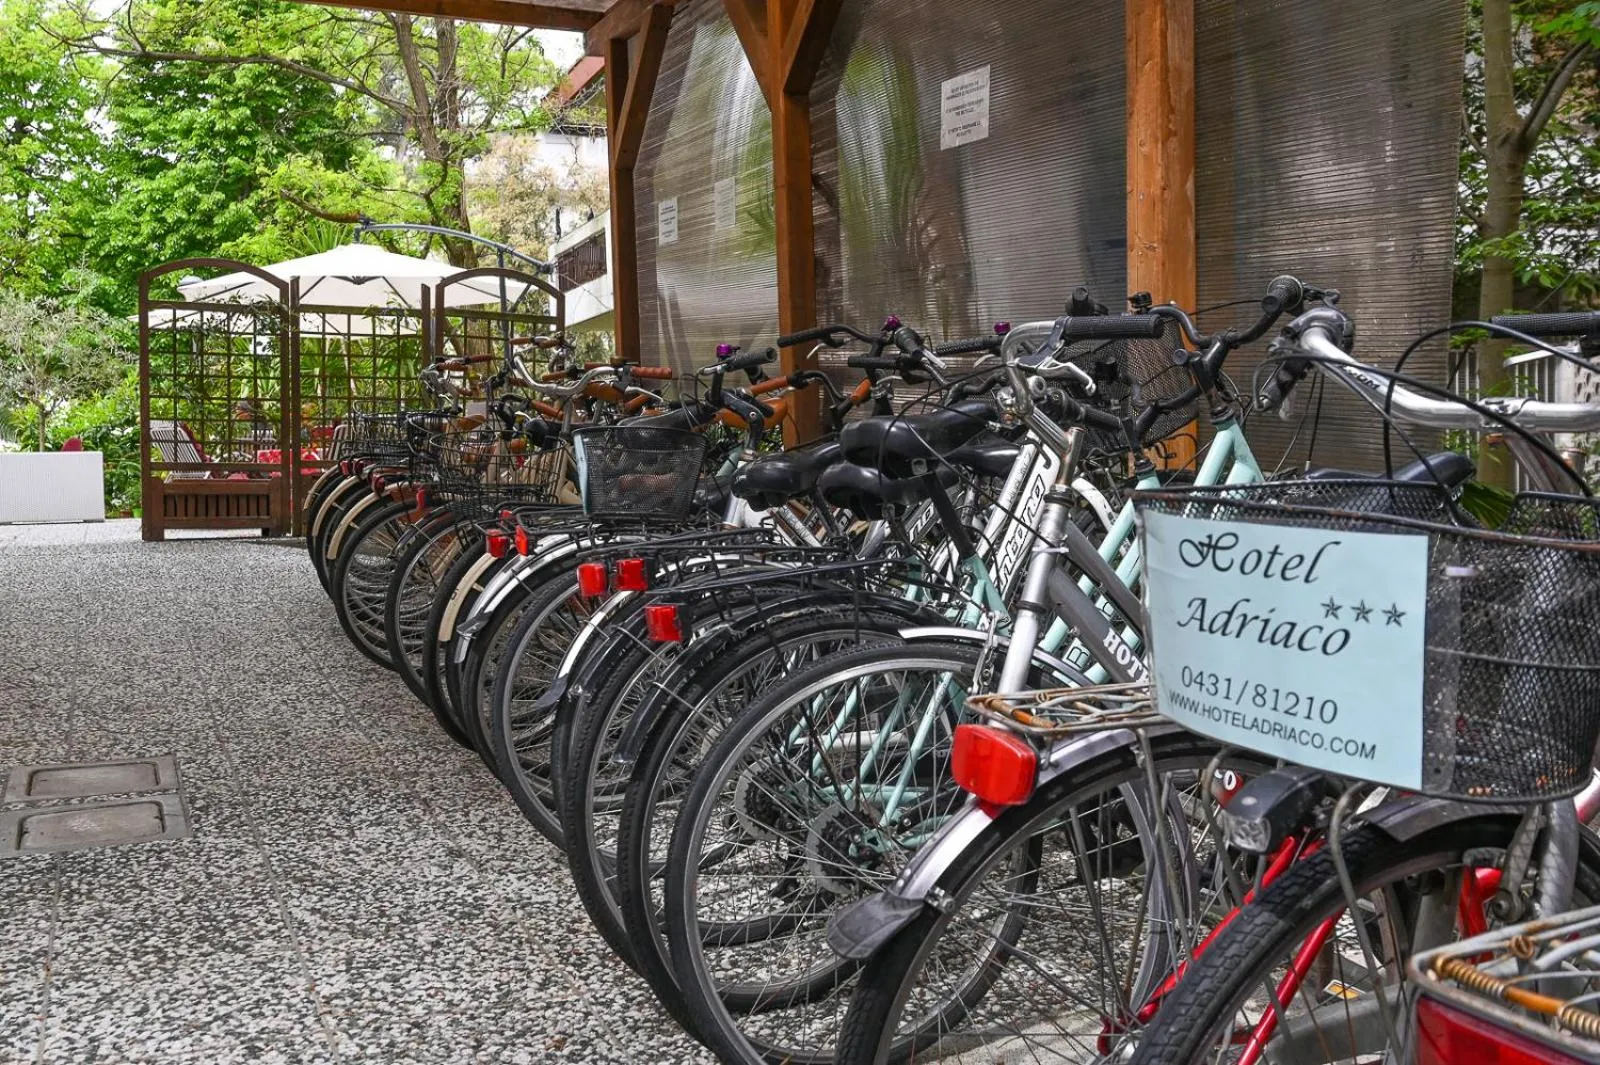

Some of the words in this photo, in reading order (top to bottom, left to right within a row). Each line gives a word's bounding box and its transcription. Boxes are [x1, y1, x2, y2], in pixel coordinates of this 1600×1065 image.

[1178, 532, 1342, 584] Hotel
[1177, 597, 1351, 656] Adriaco
[1181, 665, 1338, 724] 0431/81210
[1168, 689, 1377, 760] WWW.HOTELADRIACO.COM
